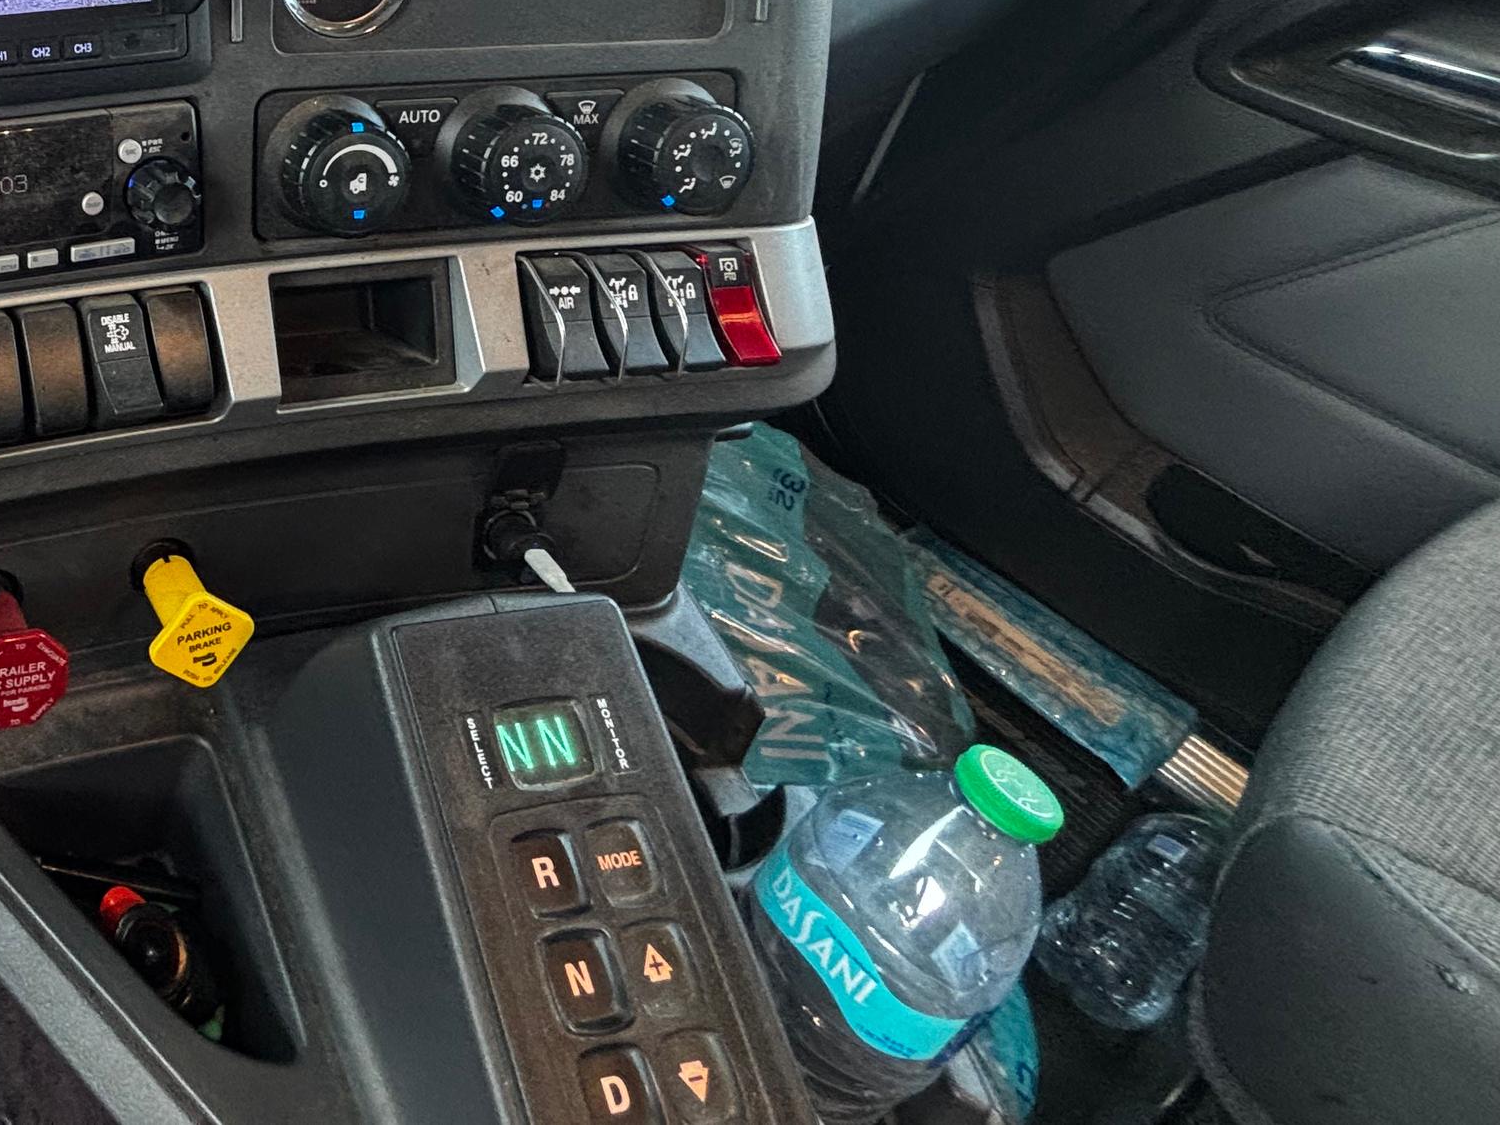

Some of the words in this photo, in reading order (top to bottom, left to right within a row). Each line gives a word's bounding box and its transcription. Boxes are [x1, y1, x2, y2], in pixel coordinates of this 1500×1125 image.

[31, 46, 51, 58] CH2
[73, 42, 93, 54] CH3
[398, 108, 441, 125] AUTO
[573, 113, 600, 125] MAX
[531, 132, 549, 146] 72
[501, 154, 519, 168] 66
[559, 153, 575, 167] 78
[506, 189, 524, 203] 60
[550, 188, 567, 202] 84
[558, 297, 575, 310] AIR
[100, 312, 130, 327] DISABLE
[104, 340, 136, 354] MANUAL
[177, 622, 232, 645] PARKING
[189, 637, 222, 653] BRAKE
[5, 671, 56, 689] SUPPLY
[597, 698, 630, 769] MONITOR
[466, 717, 493, 789] SELECT
[596, 849, 642, 871] MODE
[531, 856, 561, 889] R
[772, 866, 878, 1007] DASANI
[564, 960, 595, 997] N
[599, 1075, 631, 1115] D
